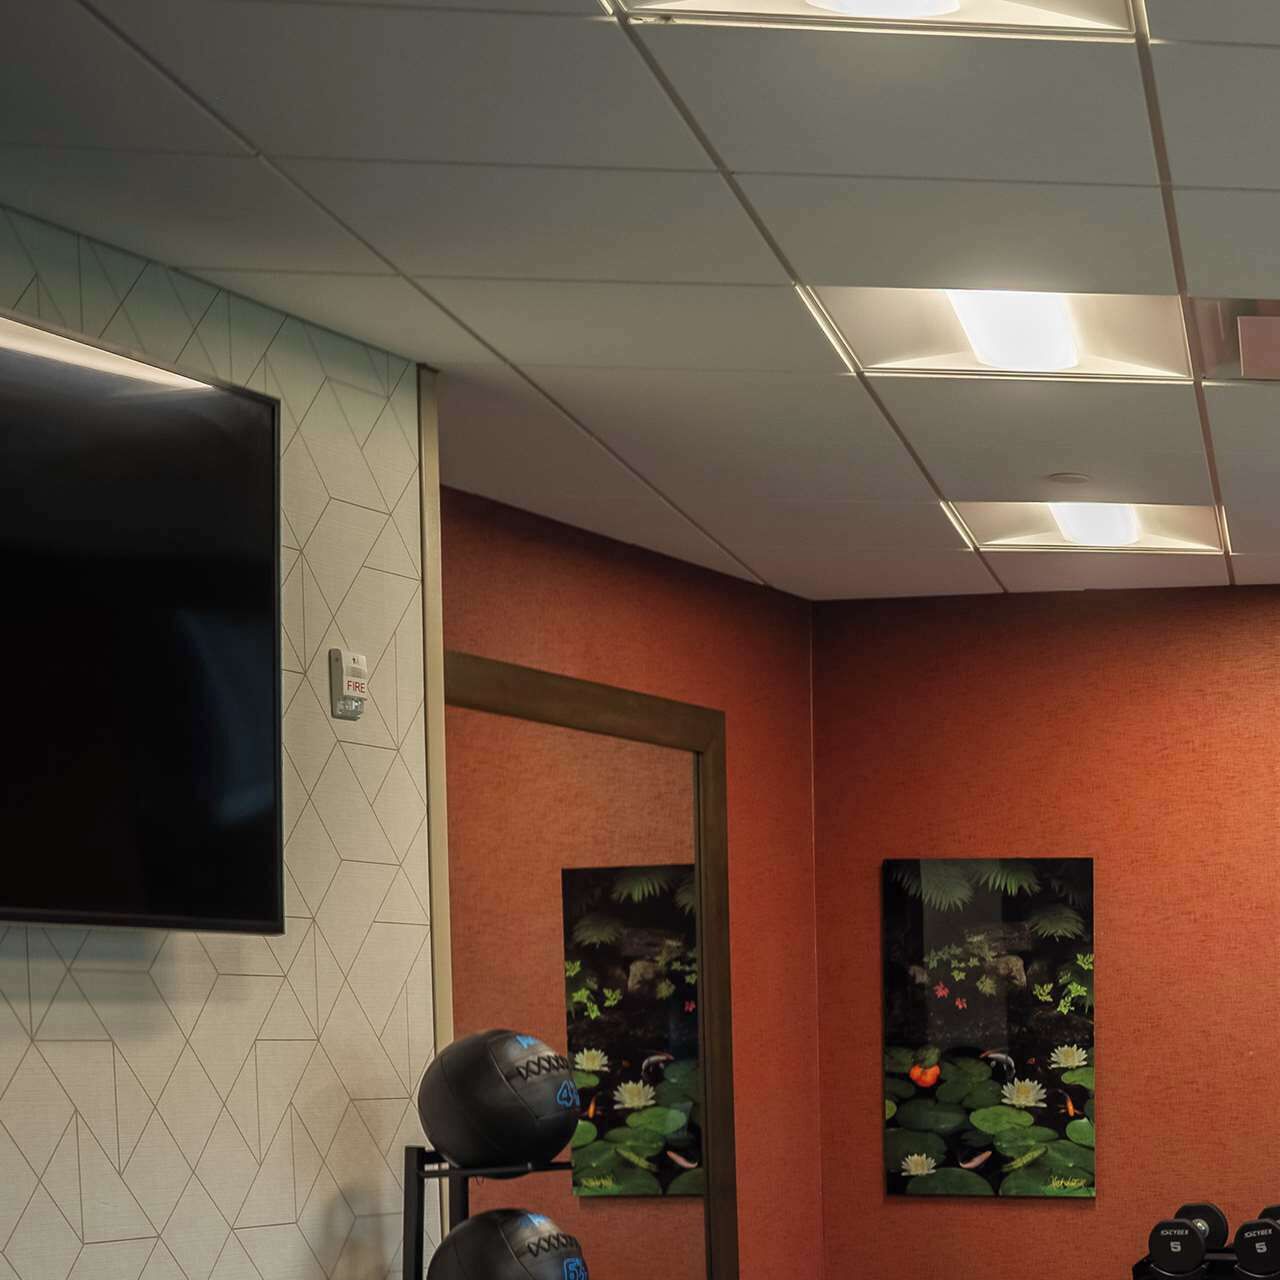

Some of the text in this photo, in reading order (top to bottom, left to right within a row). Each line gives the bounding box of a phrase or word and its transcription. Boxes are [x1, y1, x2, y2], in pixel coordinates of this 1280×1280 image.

[346, 680, 366, 694] FIRE
[1170, 1242, 1181, 1252] 5
[1256, 1242, 1267, 1252] 5
